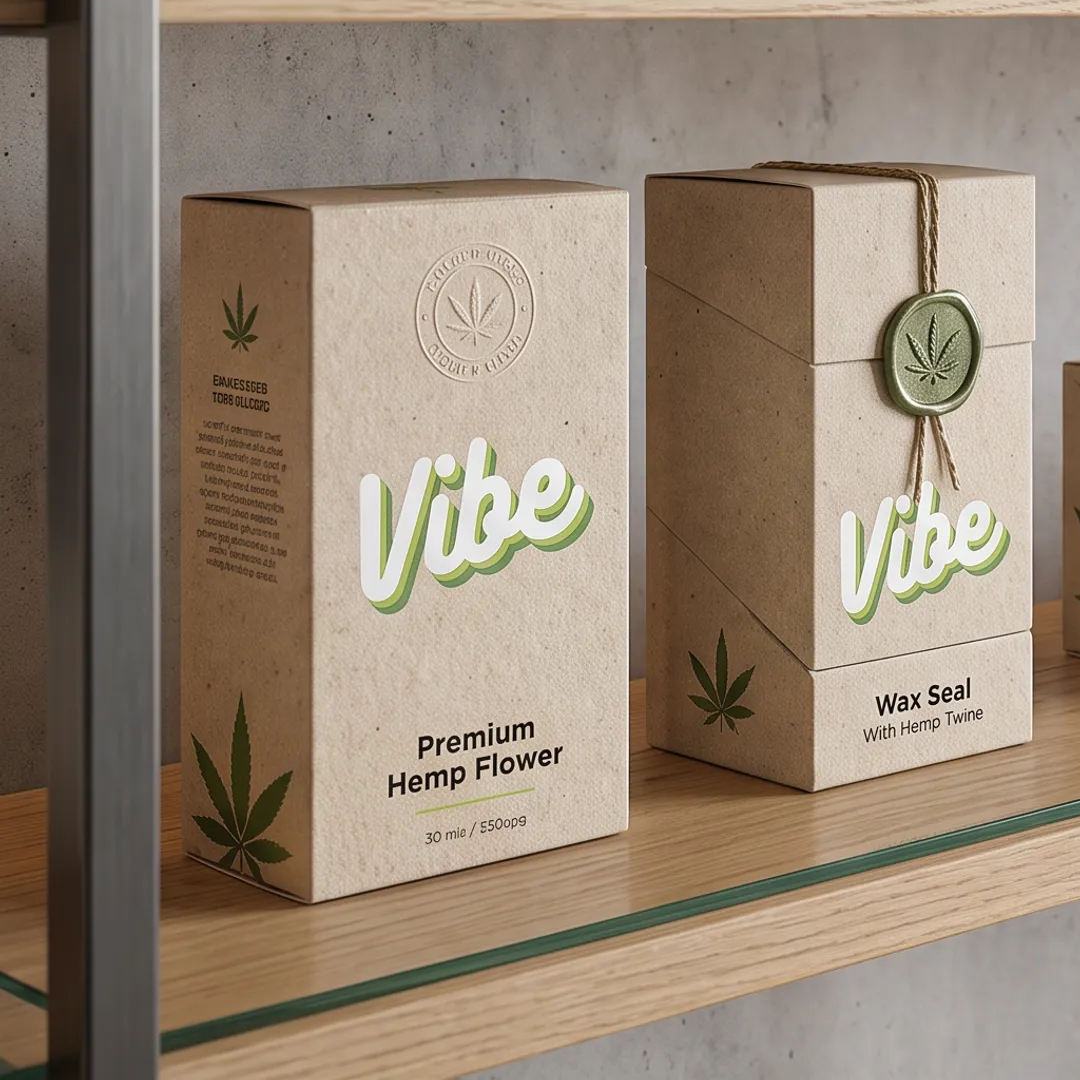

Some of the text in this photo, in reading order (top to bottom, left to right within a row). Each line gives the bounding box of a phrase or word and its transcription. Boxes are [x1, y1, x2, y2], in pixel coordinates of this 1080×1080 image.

[359, 436, 595, 615] Vibe
[840, 480, 1011, 626] Vibe
[875, 676, 971, 717] Wax Seal
[417, 720, 535, 760] Premium
[863, 708, 984, 743] With Hemp Twine
[387, 745, 564, 798] Hemp Flower
[424, 831, 442, 845] 30
